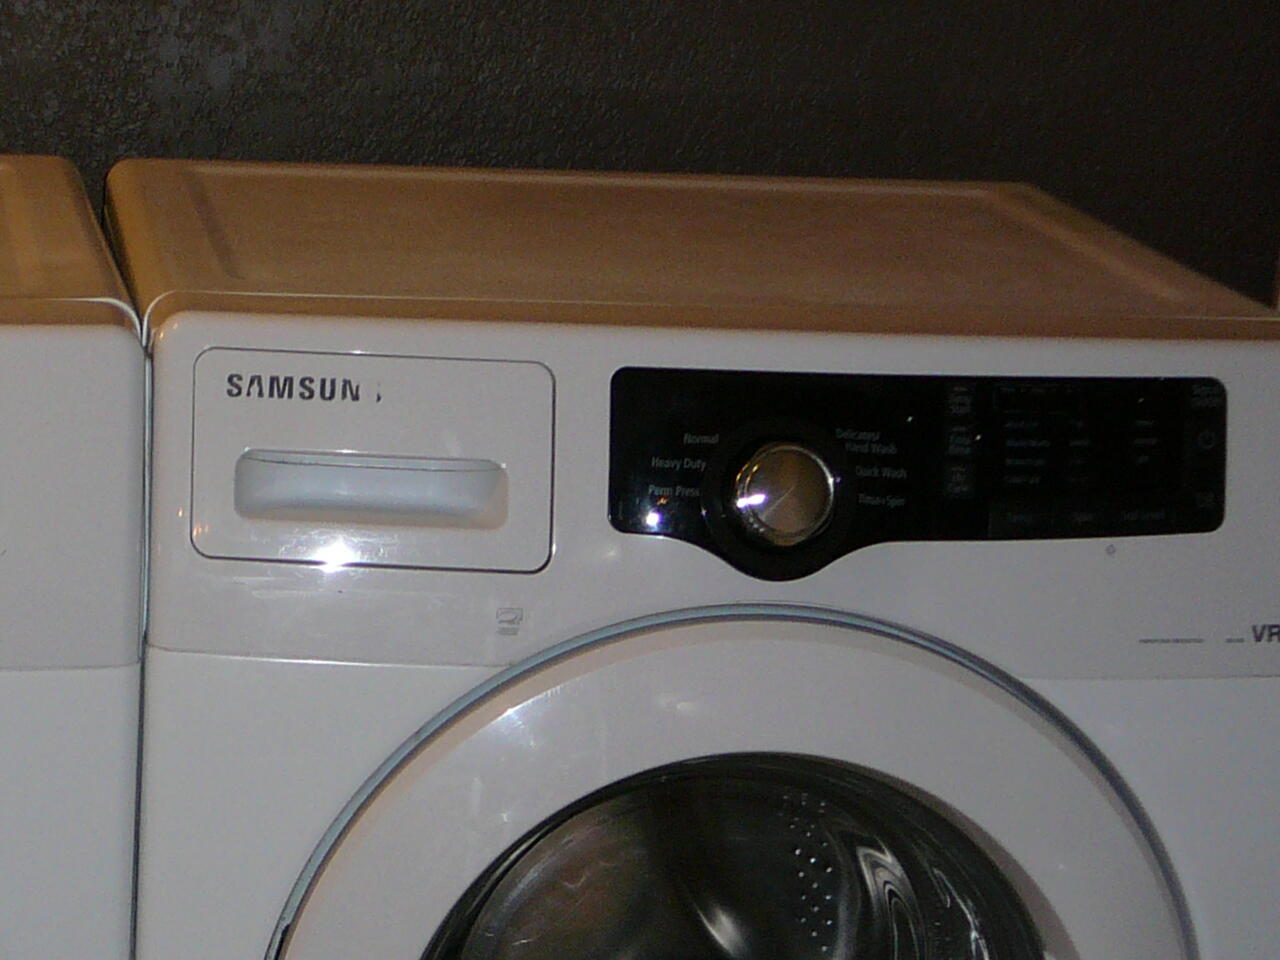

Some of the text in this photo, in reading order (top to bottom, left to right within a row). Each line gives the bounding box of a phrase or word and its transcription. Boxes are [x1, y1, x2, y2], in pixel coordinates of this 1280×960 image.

[226, 373, 382, 403] SAMSUN
[651, 457, 707, 472] Heavy Duty
